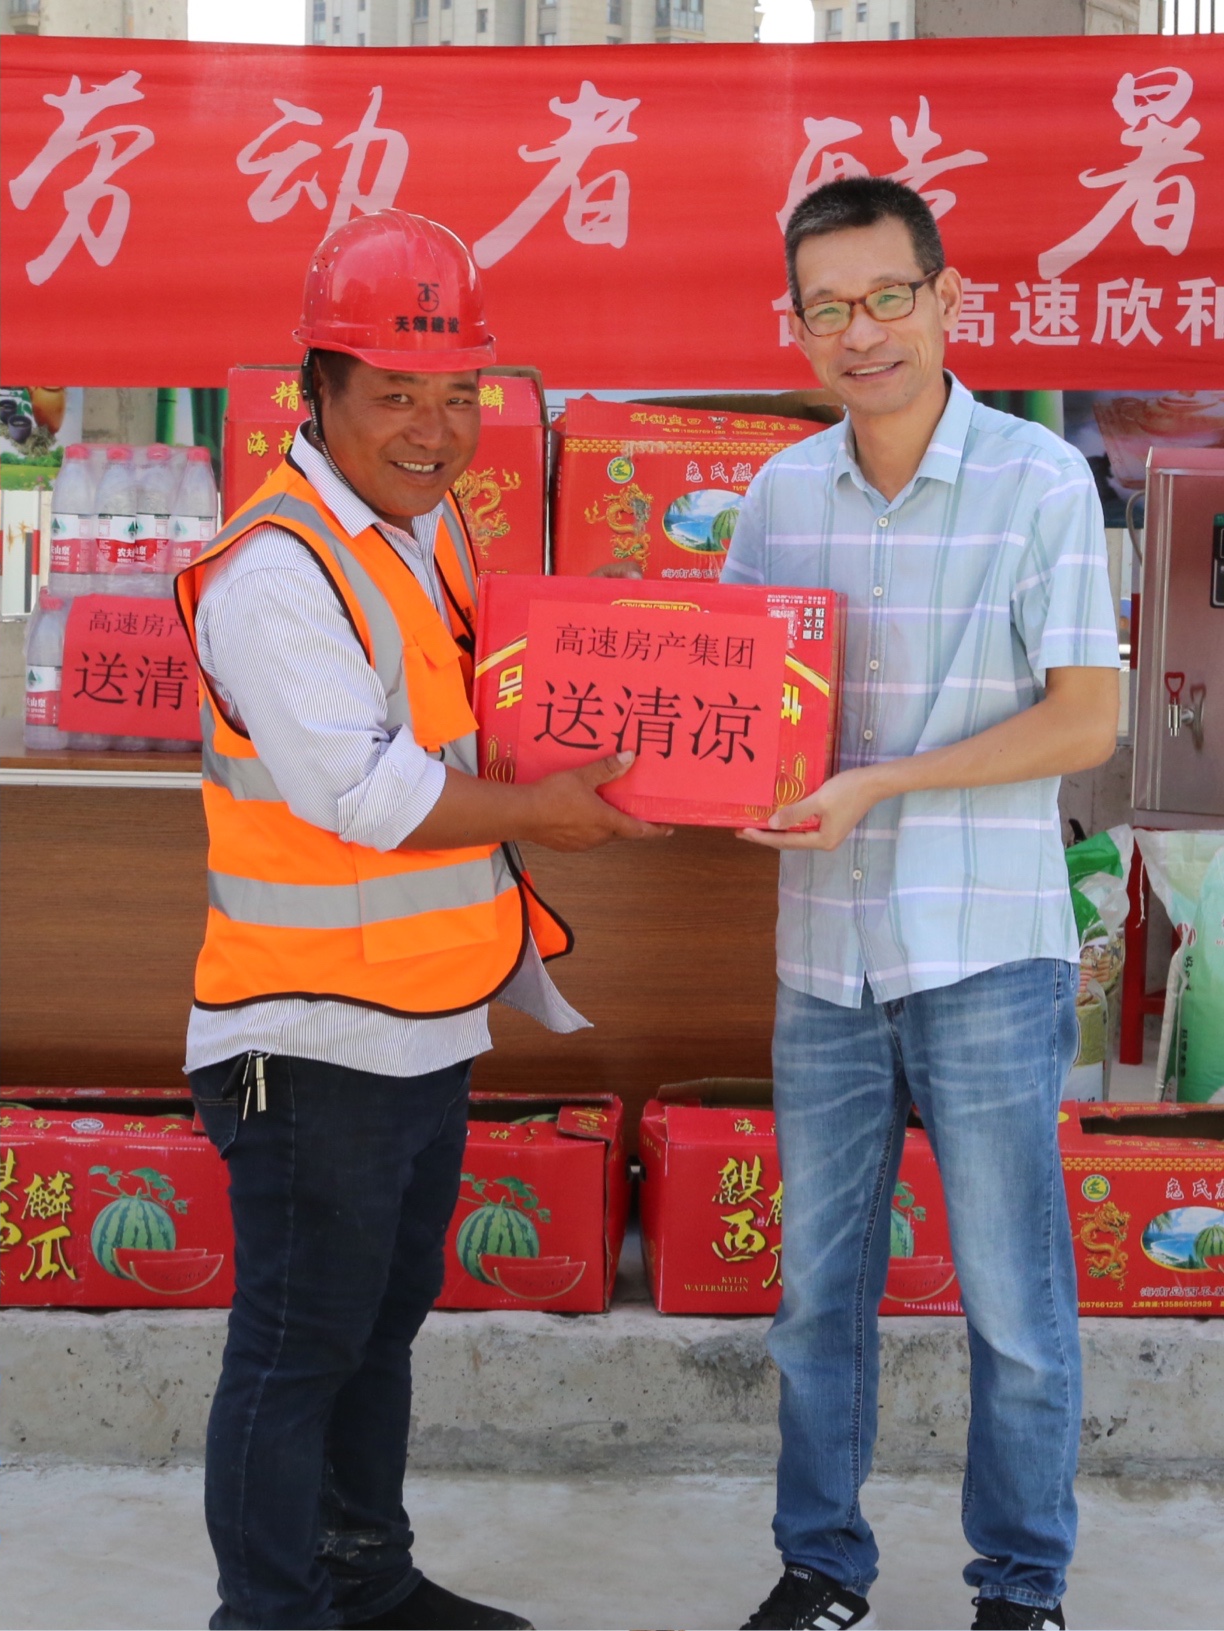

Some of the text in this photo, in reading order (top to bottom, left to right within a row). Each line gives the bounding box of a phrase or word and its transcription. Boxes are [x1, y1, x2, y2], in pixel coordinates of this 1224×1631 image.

[395, 315, 460, 335] 天颂建设
[555, 623, 755, 670] 高速房产集团
[533, 679, 761, 765] 送清凉
[684, 1284, 750, 1294] WATERMELON
[721, 1276, 750, 1285] KYLIN
